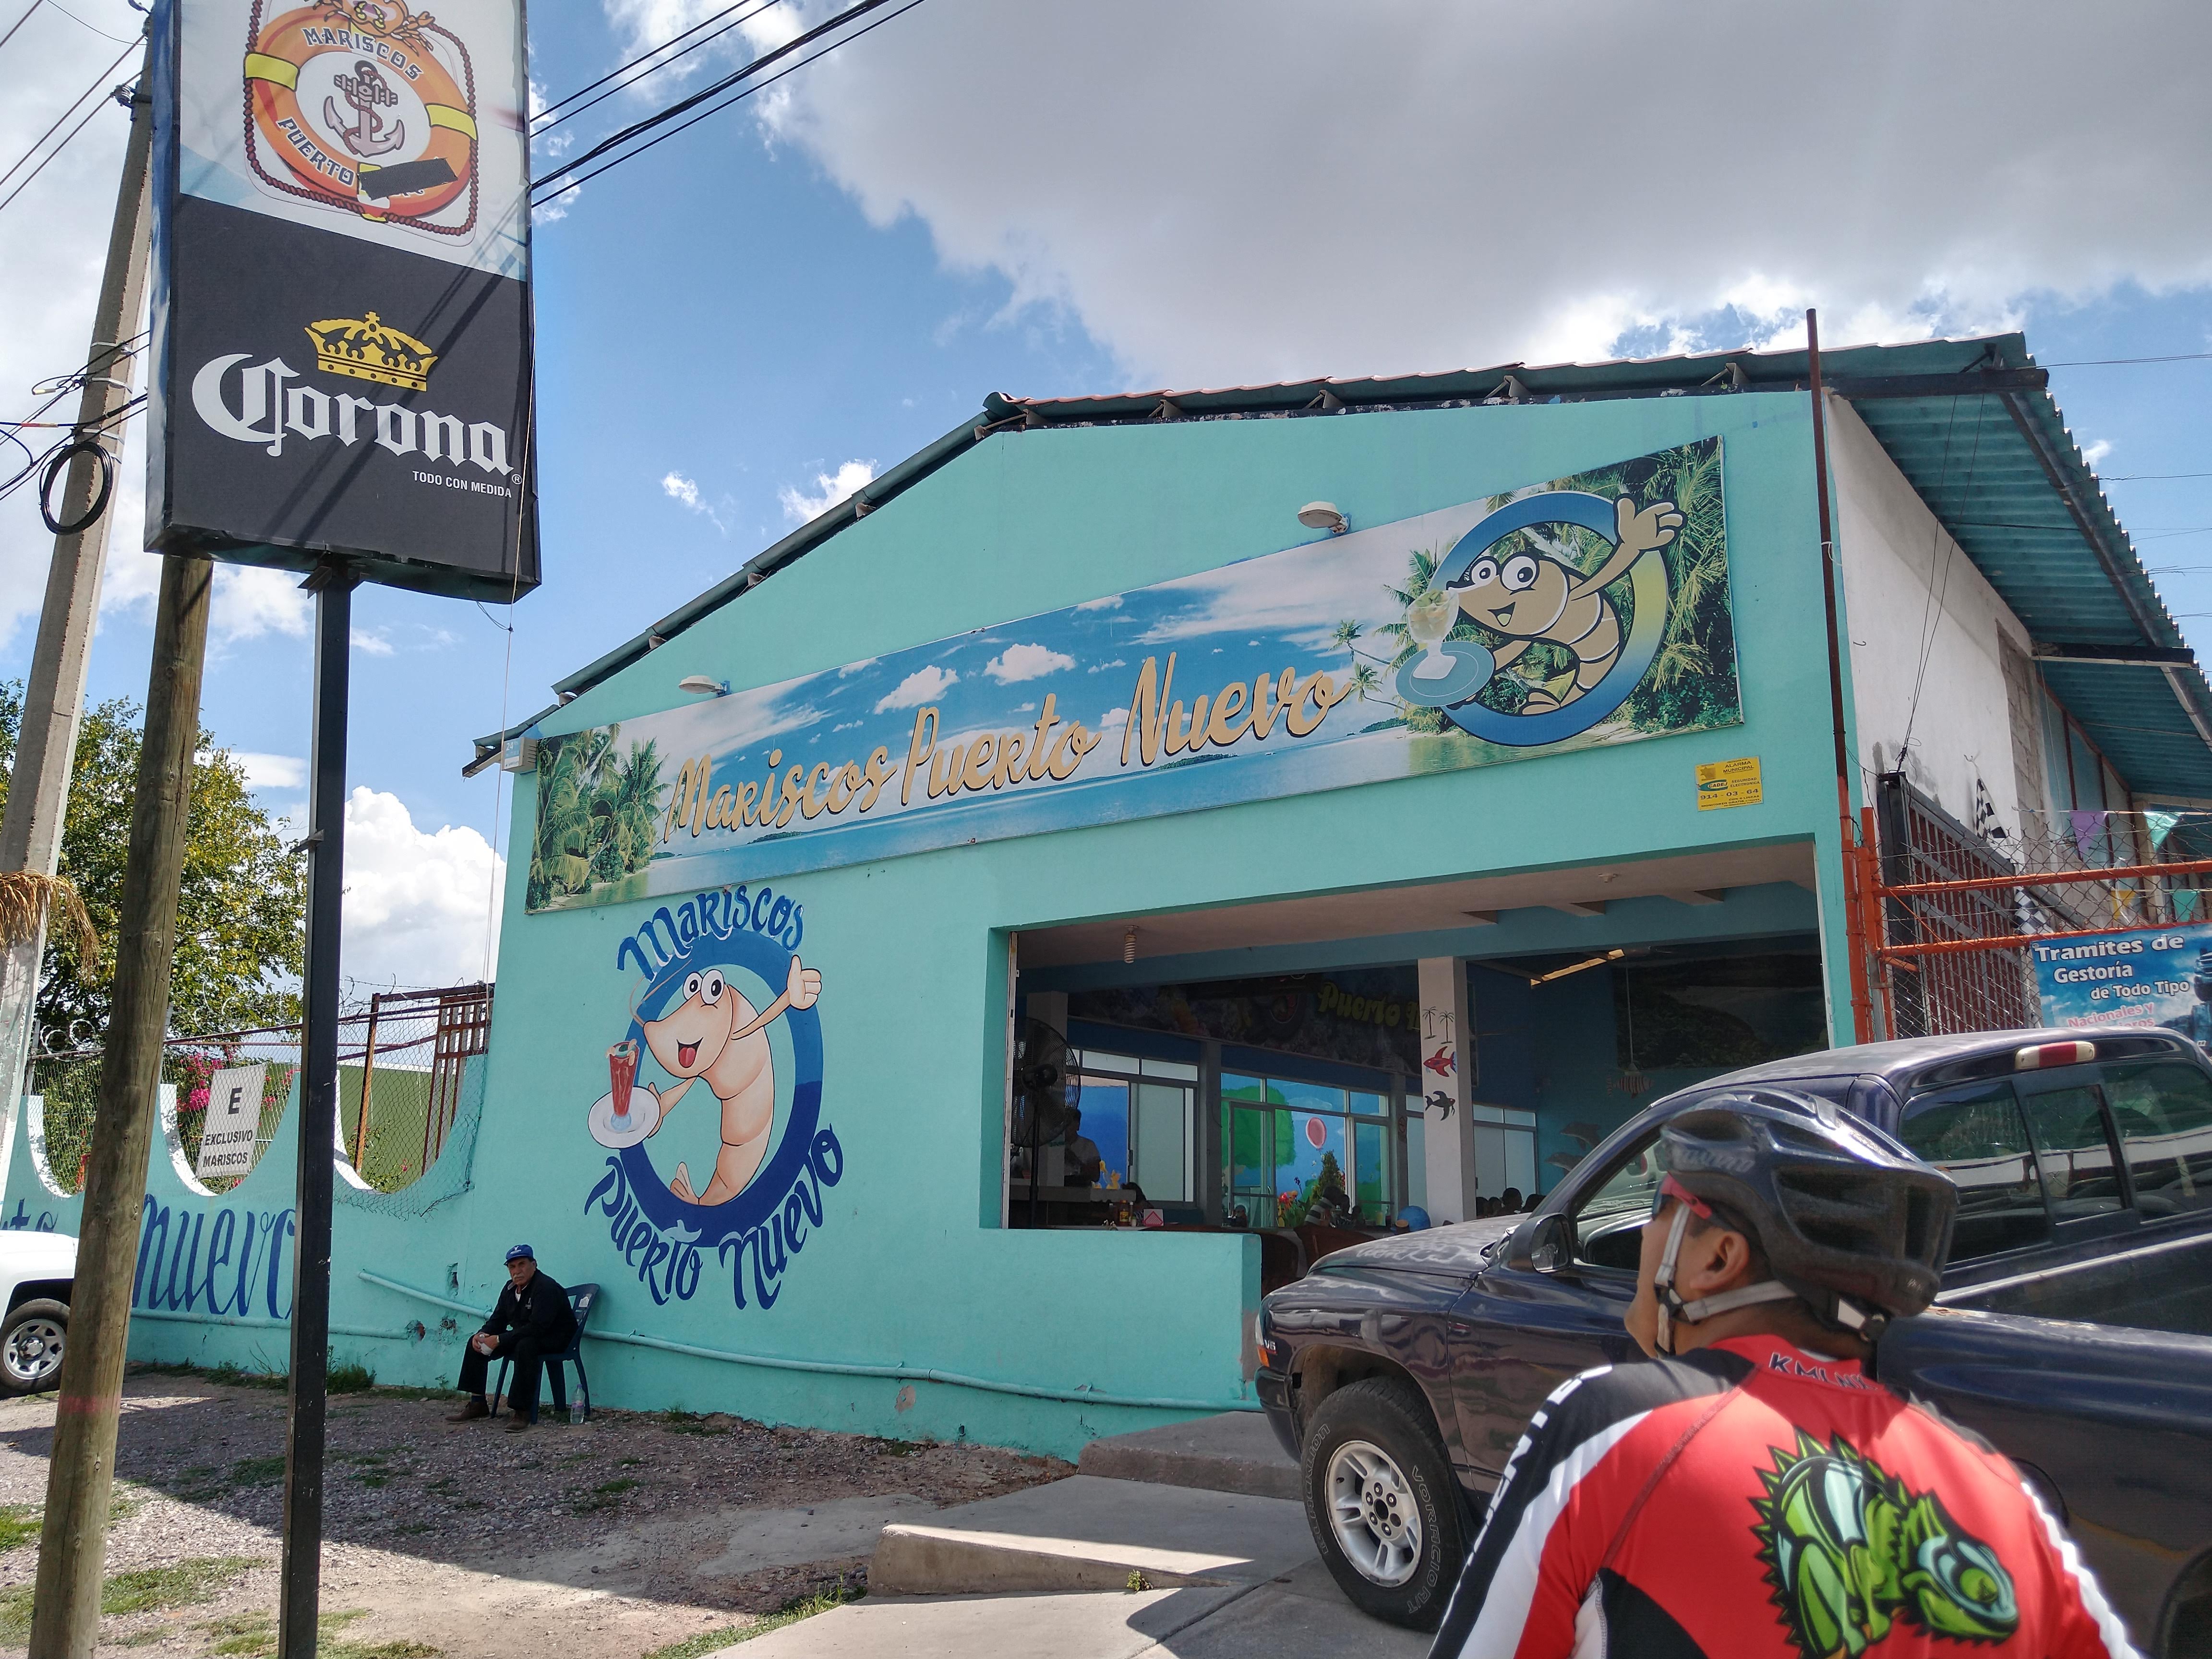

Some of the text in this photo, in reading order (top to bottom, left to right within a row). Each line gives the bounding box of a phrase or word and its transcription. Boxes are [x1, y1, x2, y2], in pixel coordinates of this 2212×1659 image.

[302, 27, 423, 80] MARISCOS
[277, 117, 355, 187] PUERTO
[192, 353, 514, 476] Corona
[413, 470, 512, 499] TODO CON MEDIDA
[1121, 651, 1352, 766] Nuevo
[2035, 934, 2184, 962] Tramites de
[2054, 961, 2133, 983] Gestoría
[1318, 982, 1401, 1027] Puerto
[2091, 980, 2189, 1000] de Todo Tipo
[2067, 1005, 2142, 1027] Nacionales
[228, 1088, 242, 1115] E
[204, 1130, 253, 1146] EXCLUSIVO
[203, 1152, 248, 1167] MARISCOS
[1304, 1424, 1330, 1555] BLACKLION
[1412, 1466, 1441, 1587] VORACIO
